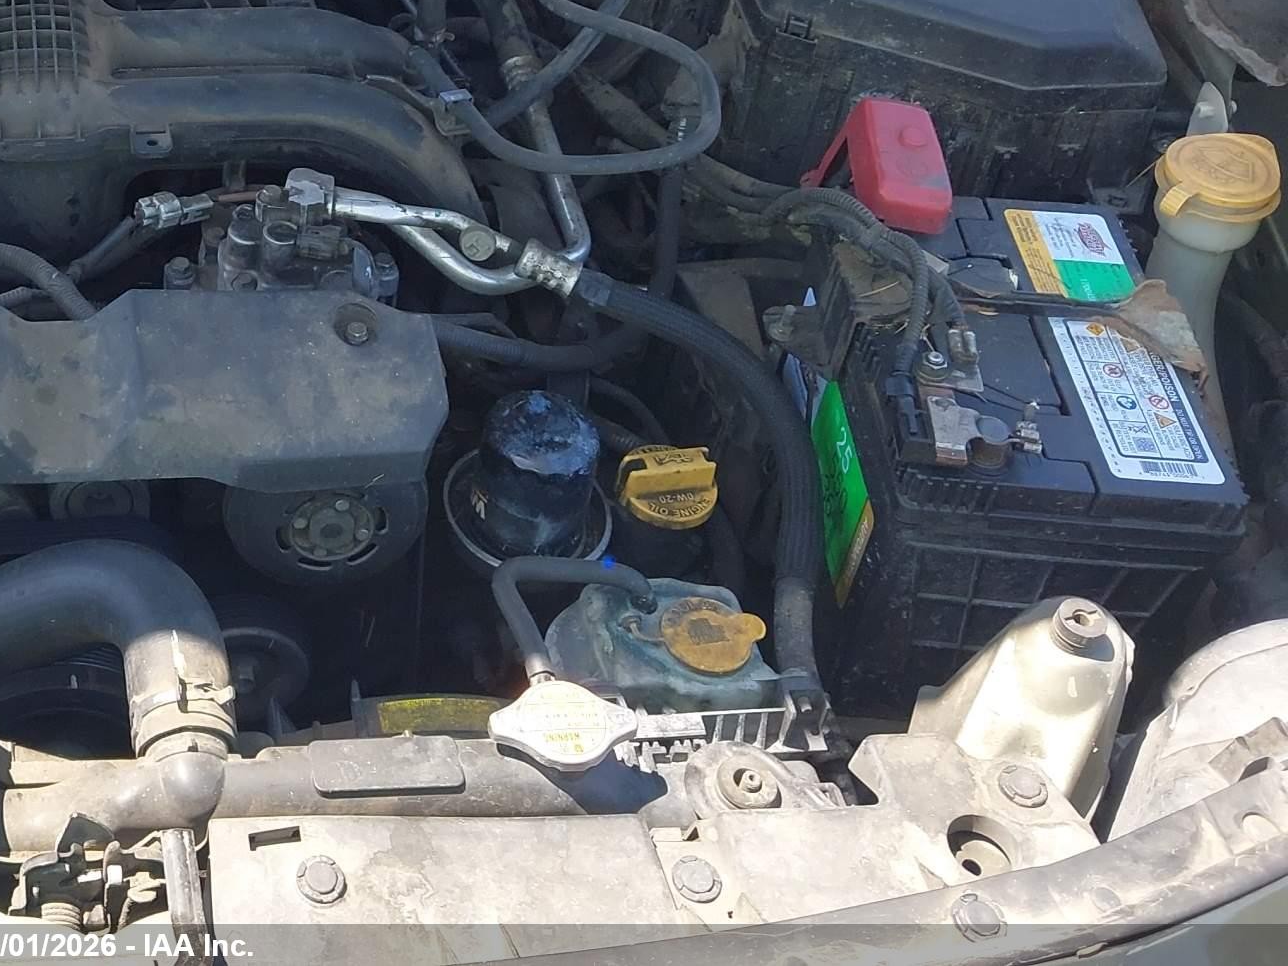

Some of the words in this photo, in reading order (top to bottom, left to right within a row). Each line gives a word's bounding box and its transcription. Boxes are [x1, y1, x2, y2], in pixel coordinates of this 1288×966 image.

[836, 427, 852, 474] 25
[659, 492, 694, 503] 0W-20
[648, 502, 669, 515] OIL
[673, 497, 712, 517] ENGINE
